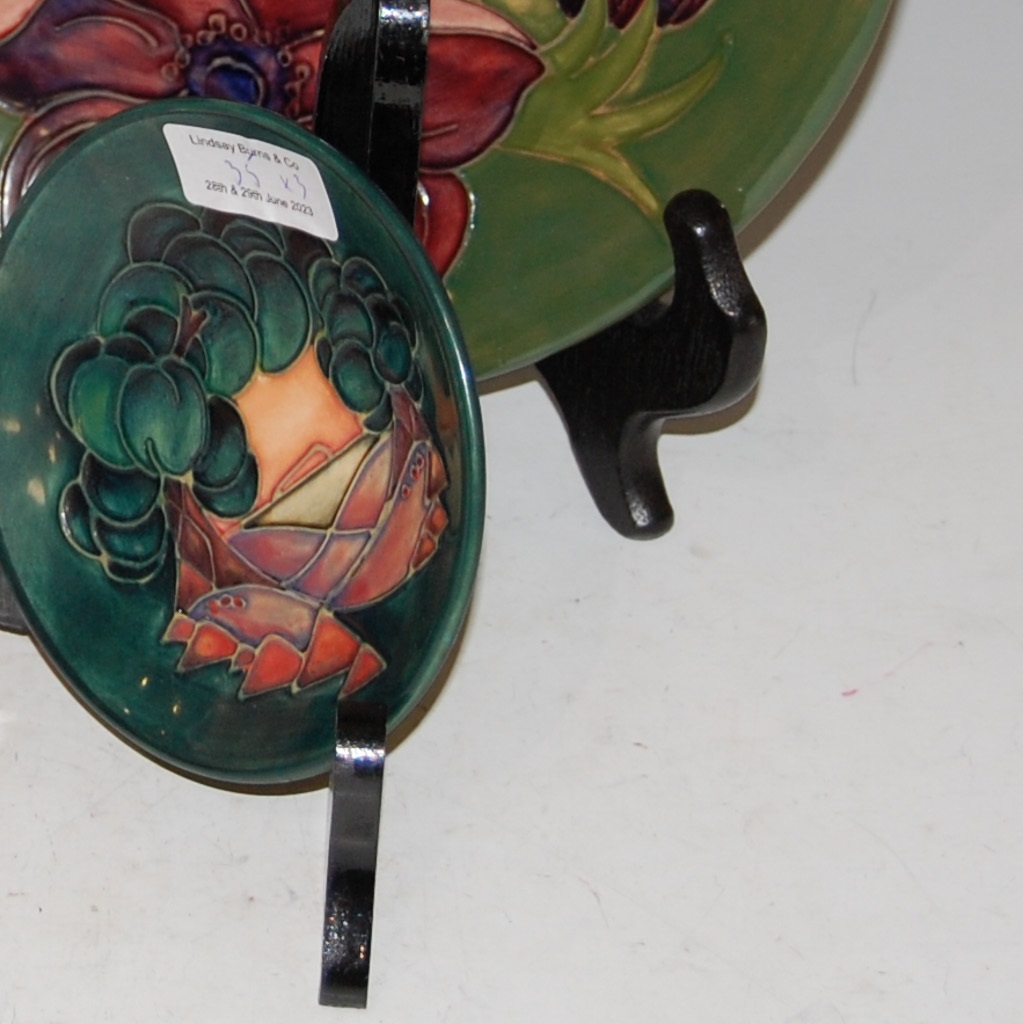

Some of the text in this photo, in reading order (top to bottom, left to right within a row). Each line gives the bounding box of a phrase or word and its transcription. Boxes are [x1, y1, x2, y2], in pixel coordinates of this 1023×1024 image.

[189, 134, 299, 171] Lindsay Burns & Co
[205, 180, 313, 216] 28th & 29th June 2023
